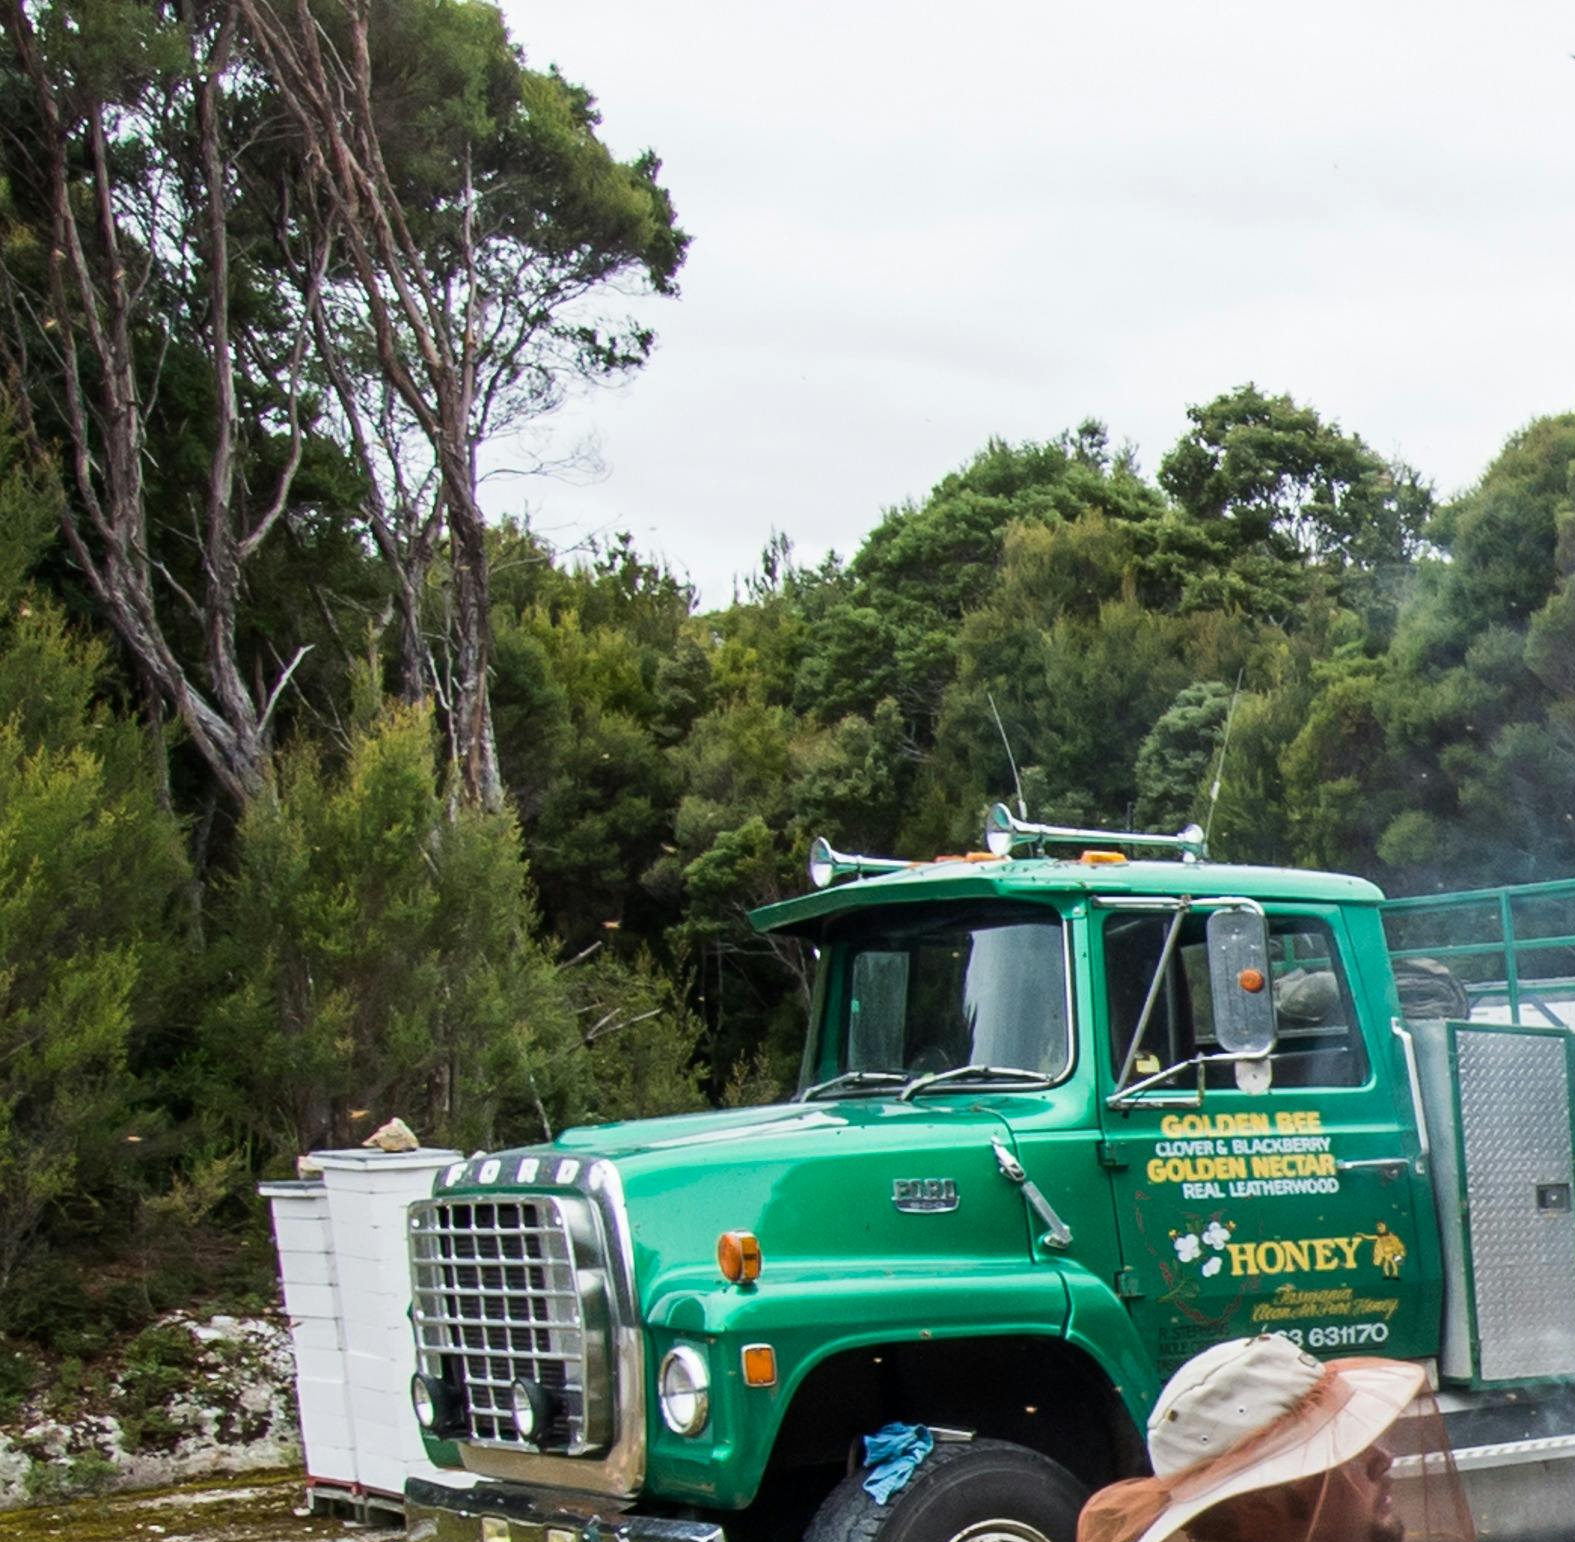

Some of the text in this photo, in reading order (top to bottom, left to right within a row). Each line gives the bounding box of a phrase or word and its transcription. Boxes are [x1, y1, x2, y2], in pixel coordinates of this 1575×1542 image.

[1161, 1111, 1323, 1138] GOLDEN BEE
[1155, 1137, 1331, 1157] CLOVER & BLACKBERRY
[445, 1158, 580, 1187] FORD
[1147, 1153, 1337, 1183] GOLDEN NECTAR
[1182, 1177, 1340, 1199] REAL LEATHERWOOD
[1226, 1237, 1362, 1276] HONEY
[1308, 1323, 1389, 1347] 631170
